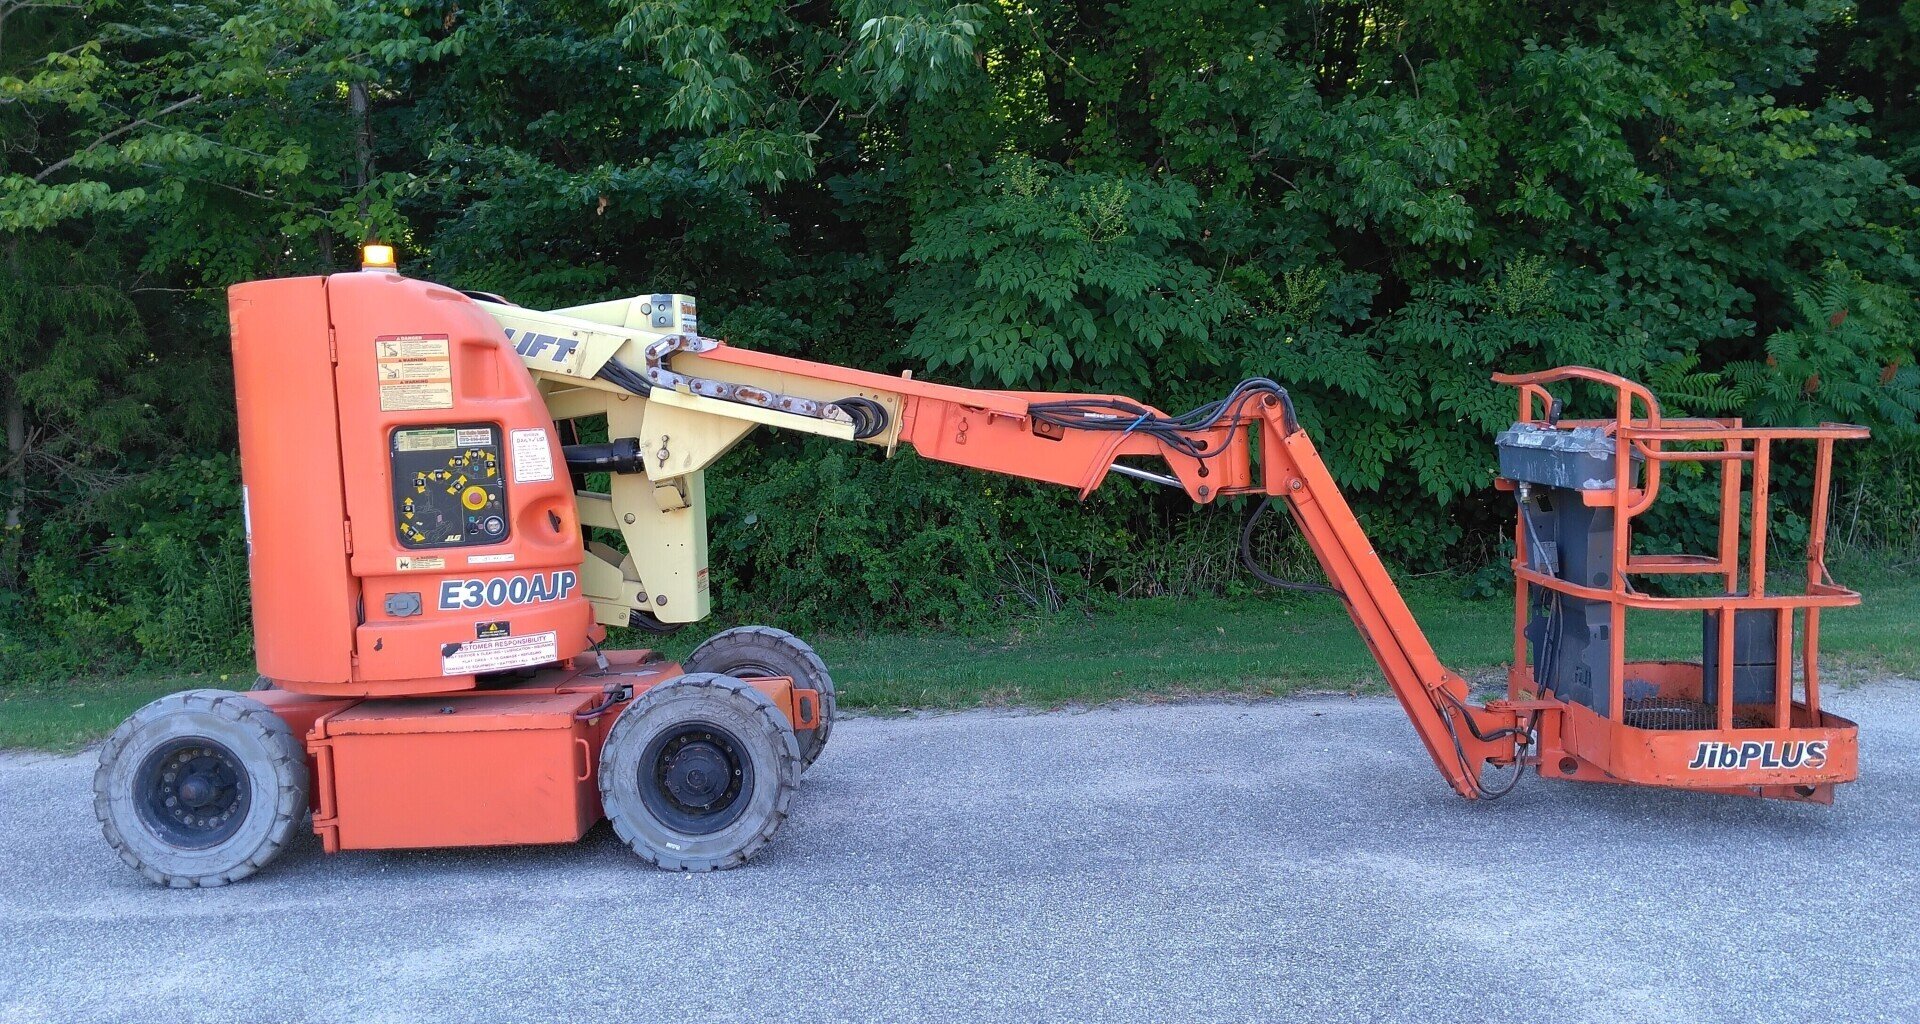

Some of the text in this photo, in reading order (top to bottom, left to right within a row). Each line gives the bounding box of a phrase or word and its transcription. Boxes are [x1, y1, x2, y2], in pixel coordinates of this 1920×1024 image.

[438, 570, 576, 611] E300AJP
[459, 635, 547, 652] USTOMER RESPONSIBILITY
[1688, 741, 1828, 769] JibPLUS
